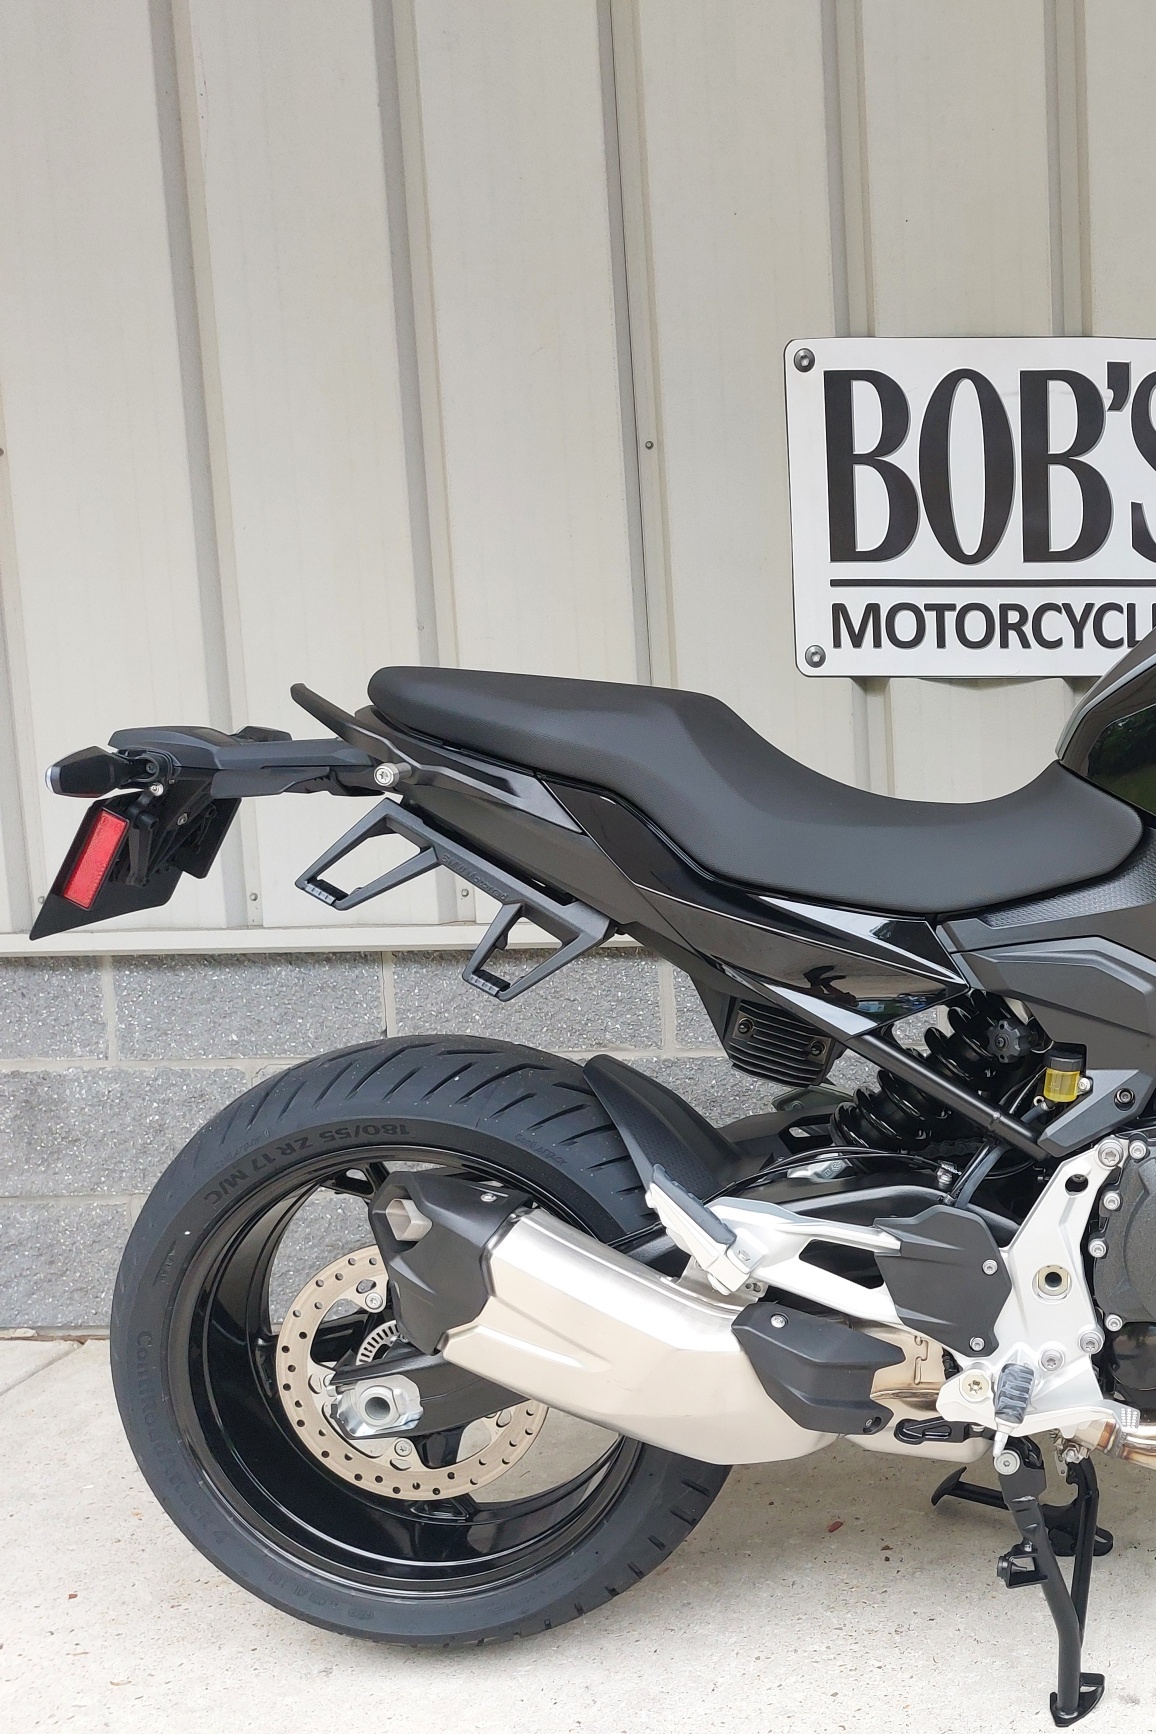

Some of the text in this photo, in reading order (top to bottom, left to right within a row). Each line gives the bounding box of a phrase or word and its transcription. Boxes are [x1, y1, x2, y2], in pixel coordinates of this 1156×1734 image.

[318, 1123, 411, 1142] 180/55
[275, 1136, 314, 1156] ZR
[251, 1153, 277, 1172] 17
[203, 1168, 249, 1205] M/C
